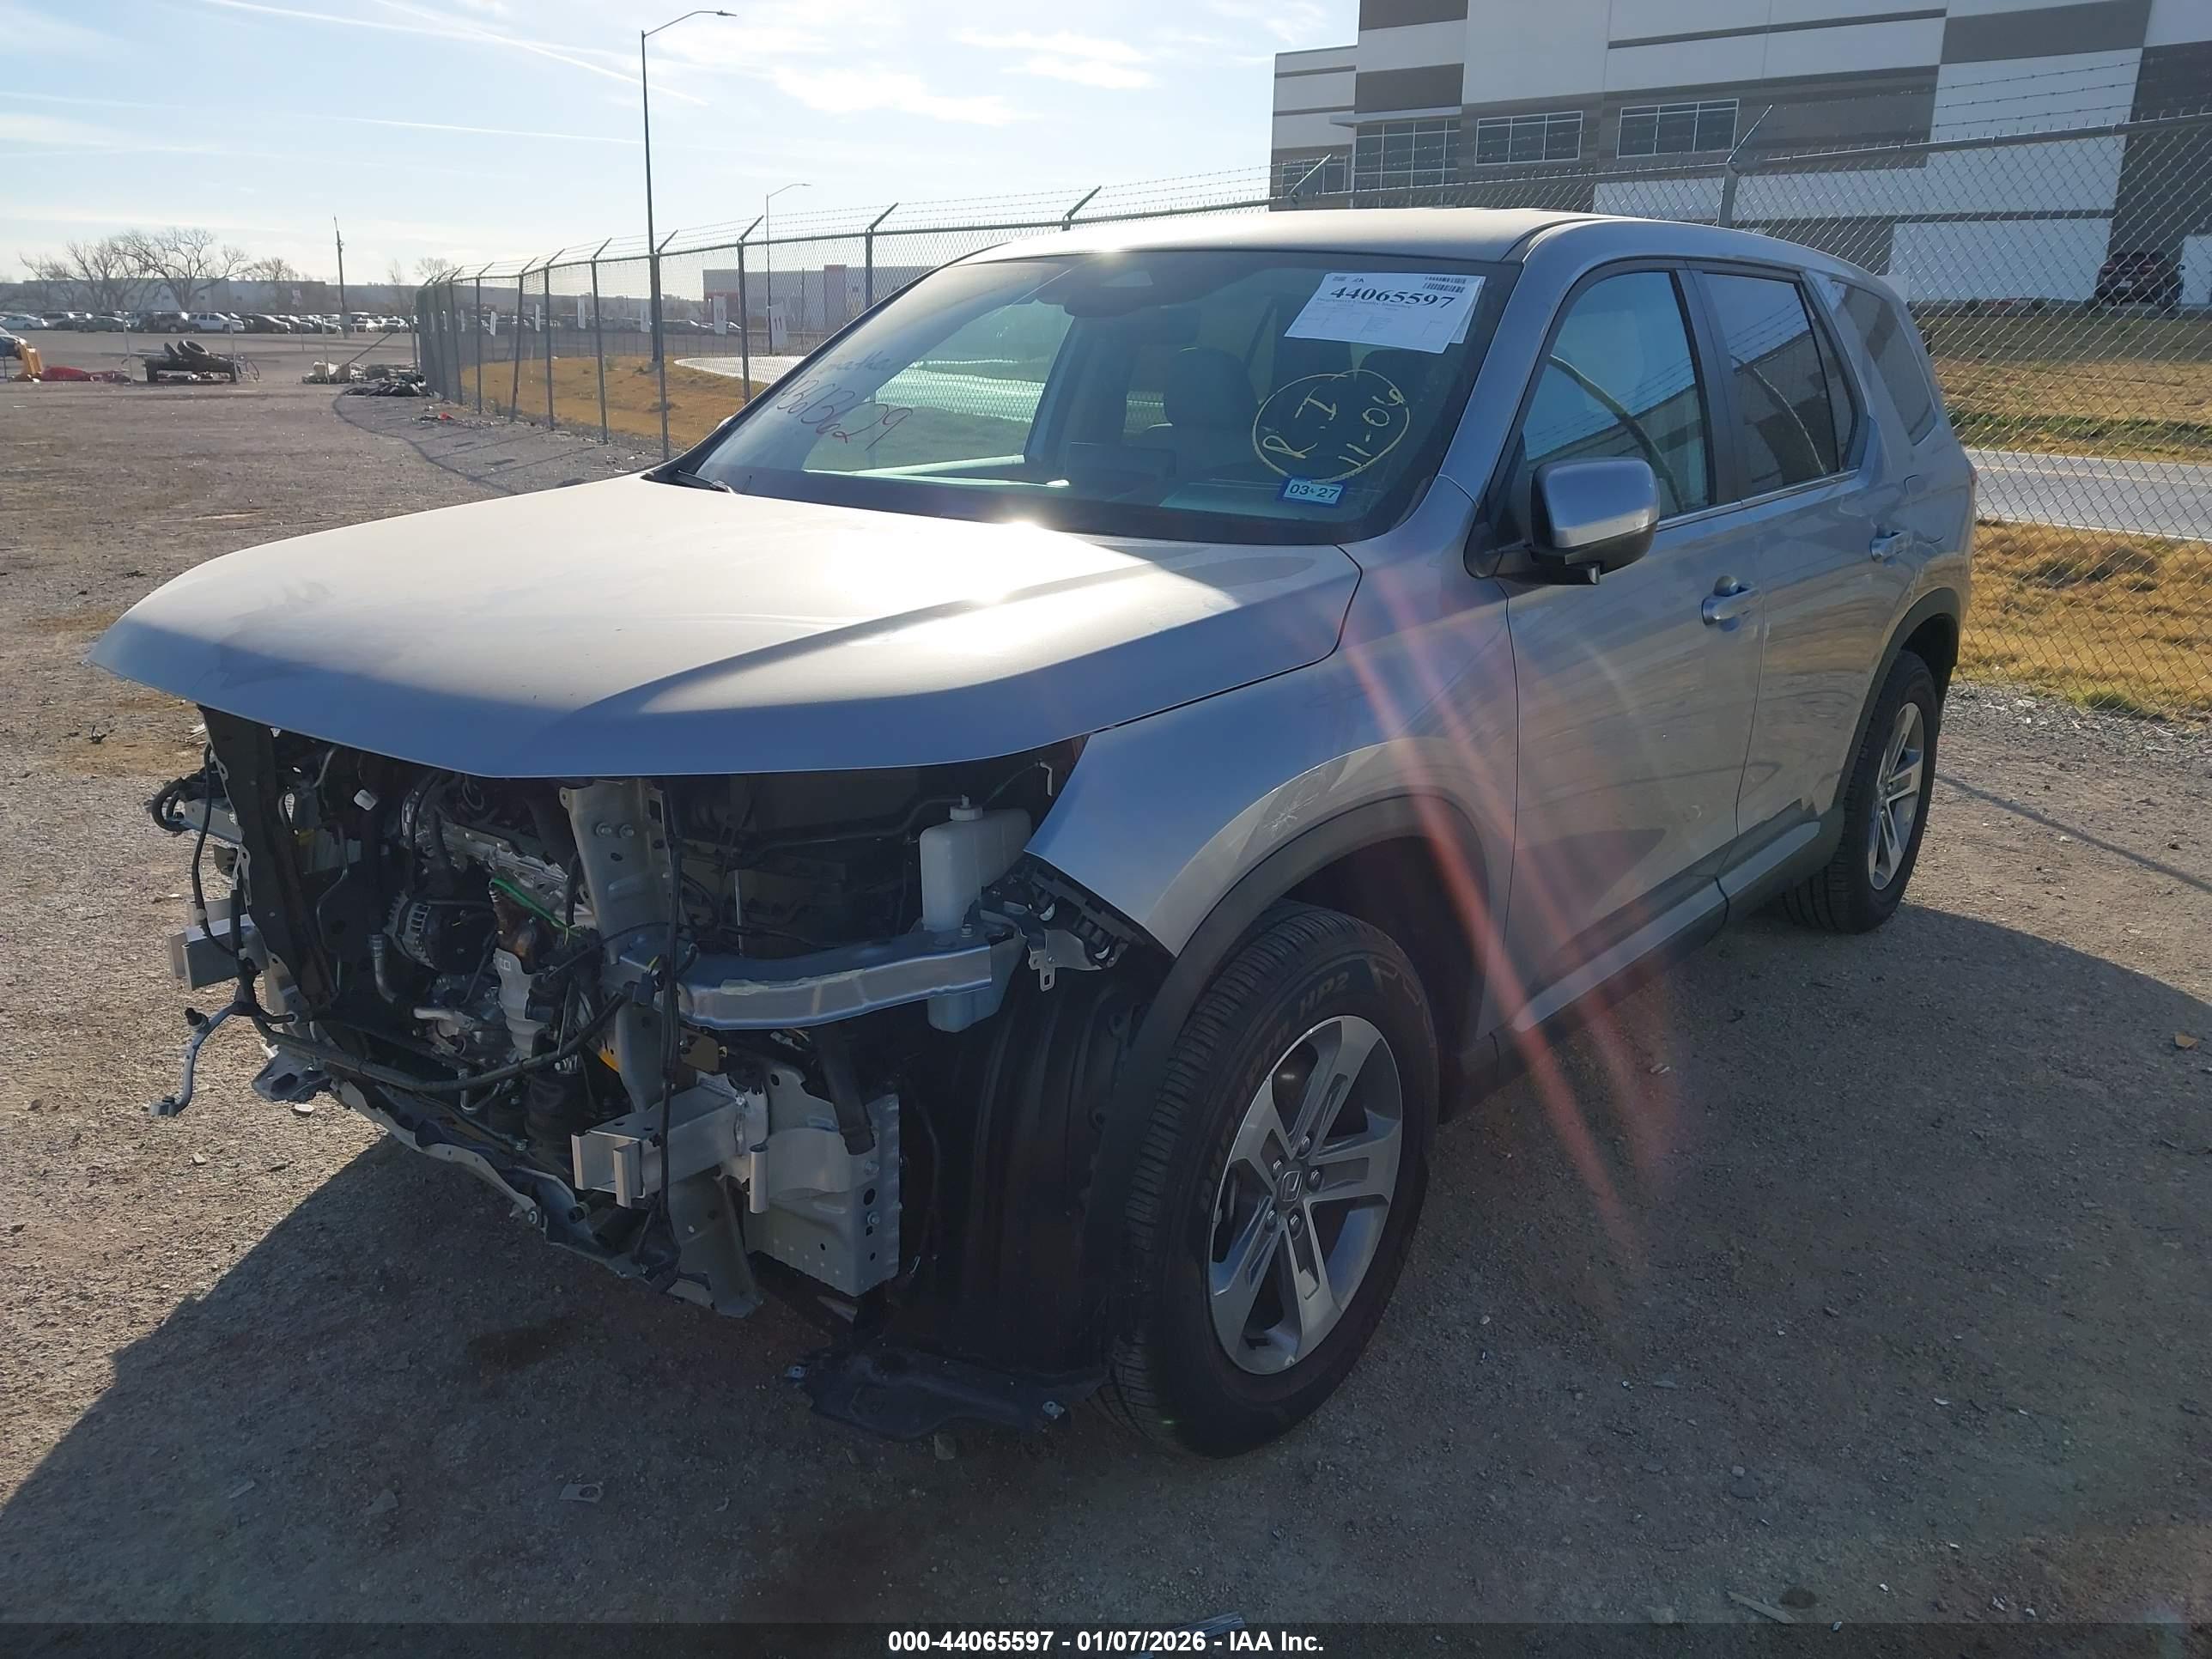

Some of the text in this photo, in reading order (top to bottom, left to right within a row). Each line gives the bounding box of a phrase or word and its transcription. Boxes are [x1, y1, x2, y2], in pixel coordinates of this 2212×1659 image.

[1330, 286, 1455, 309] 44065597
[1290, 483, 1340, 499] 03 27
